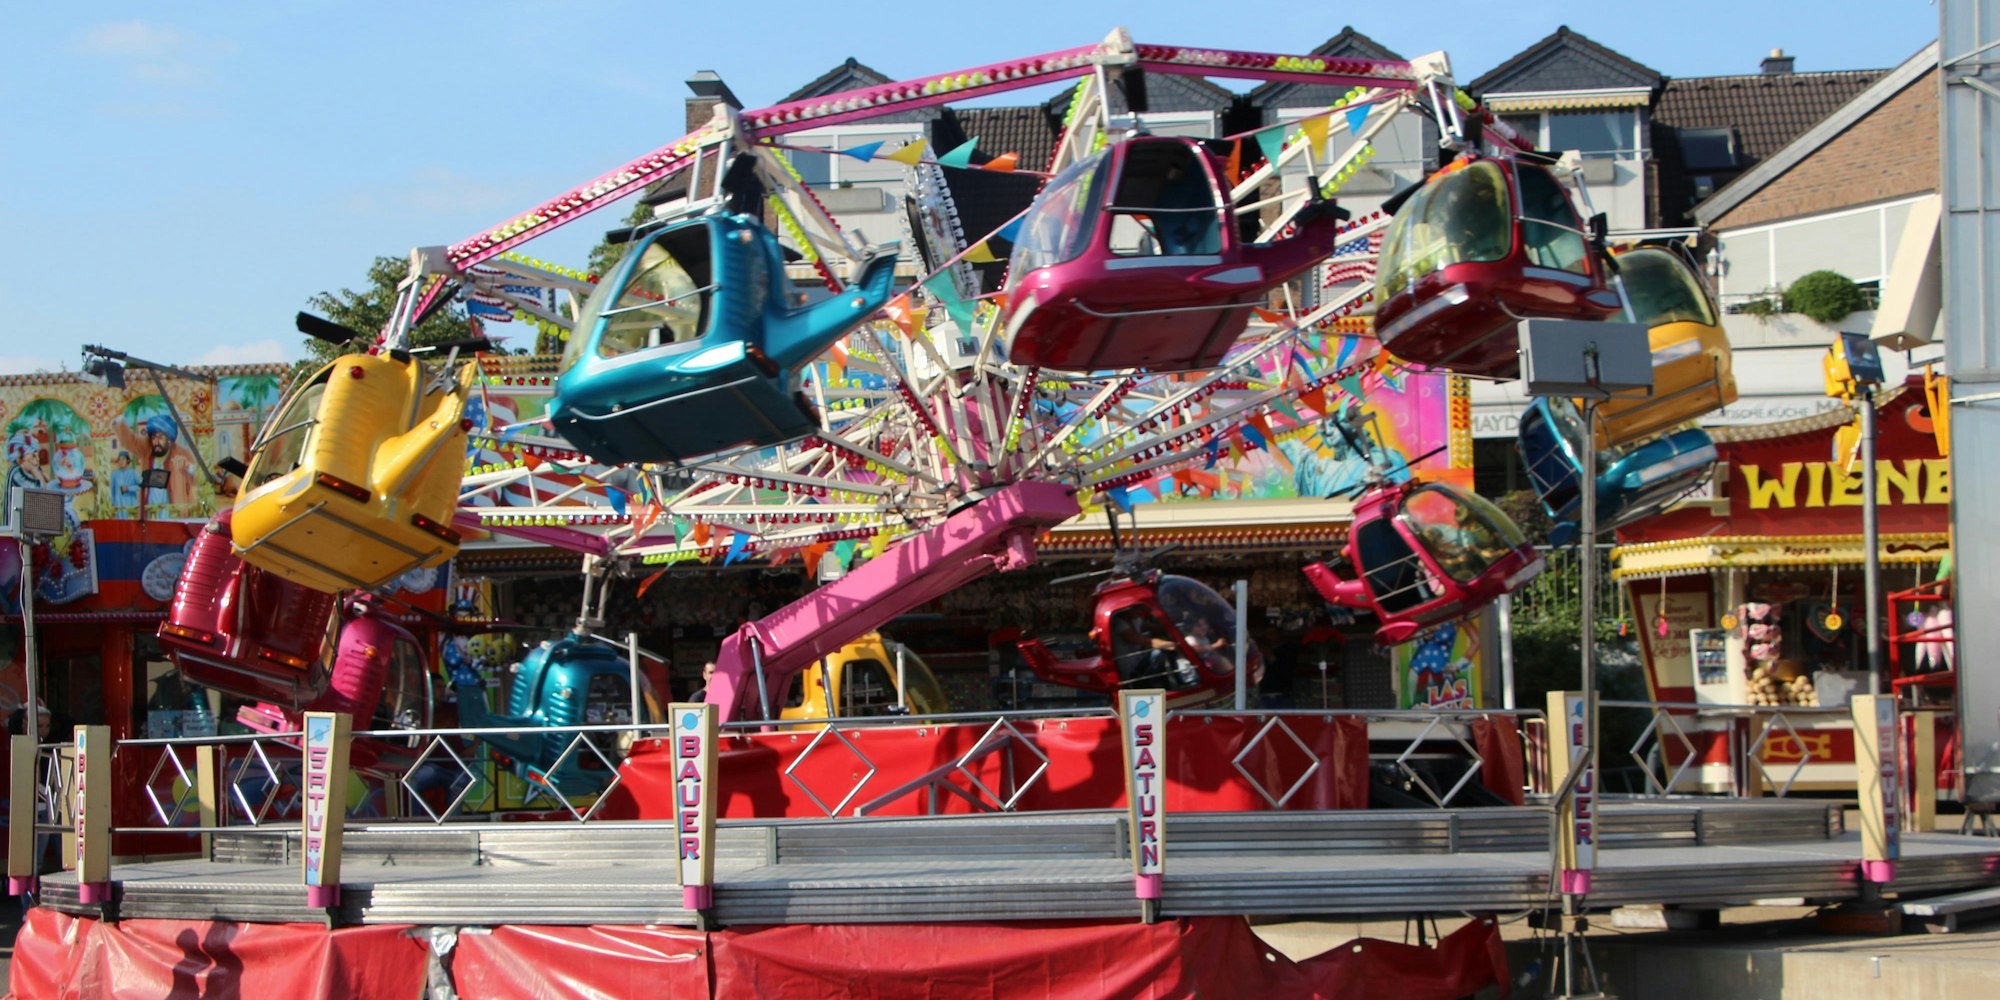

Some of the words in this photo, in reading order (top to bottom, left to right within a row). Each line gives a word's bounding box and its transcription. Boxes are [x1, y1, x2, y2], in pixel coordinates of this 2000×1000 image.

[1429, 679, 1468, 706] LAS
[77, 753, 86, 860] BAUER
[307, 747, 329, 872] SATURN
[677, 735, 701, 860] BAUER
[1134, 724, 1159, 867] SATURN
[1572, 723, 1594, 845] BUER
